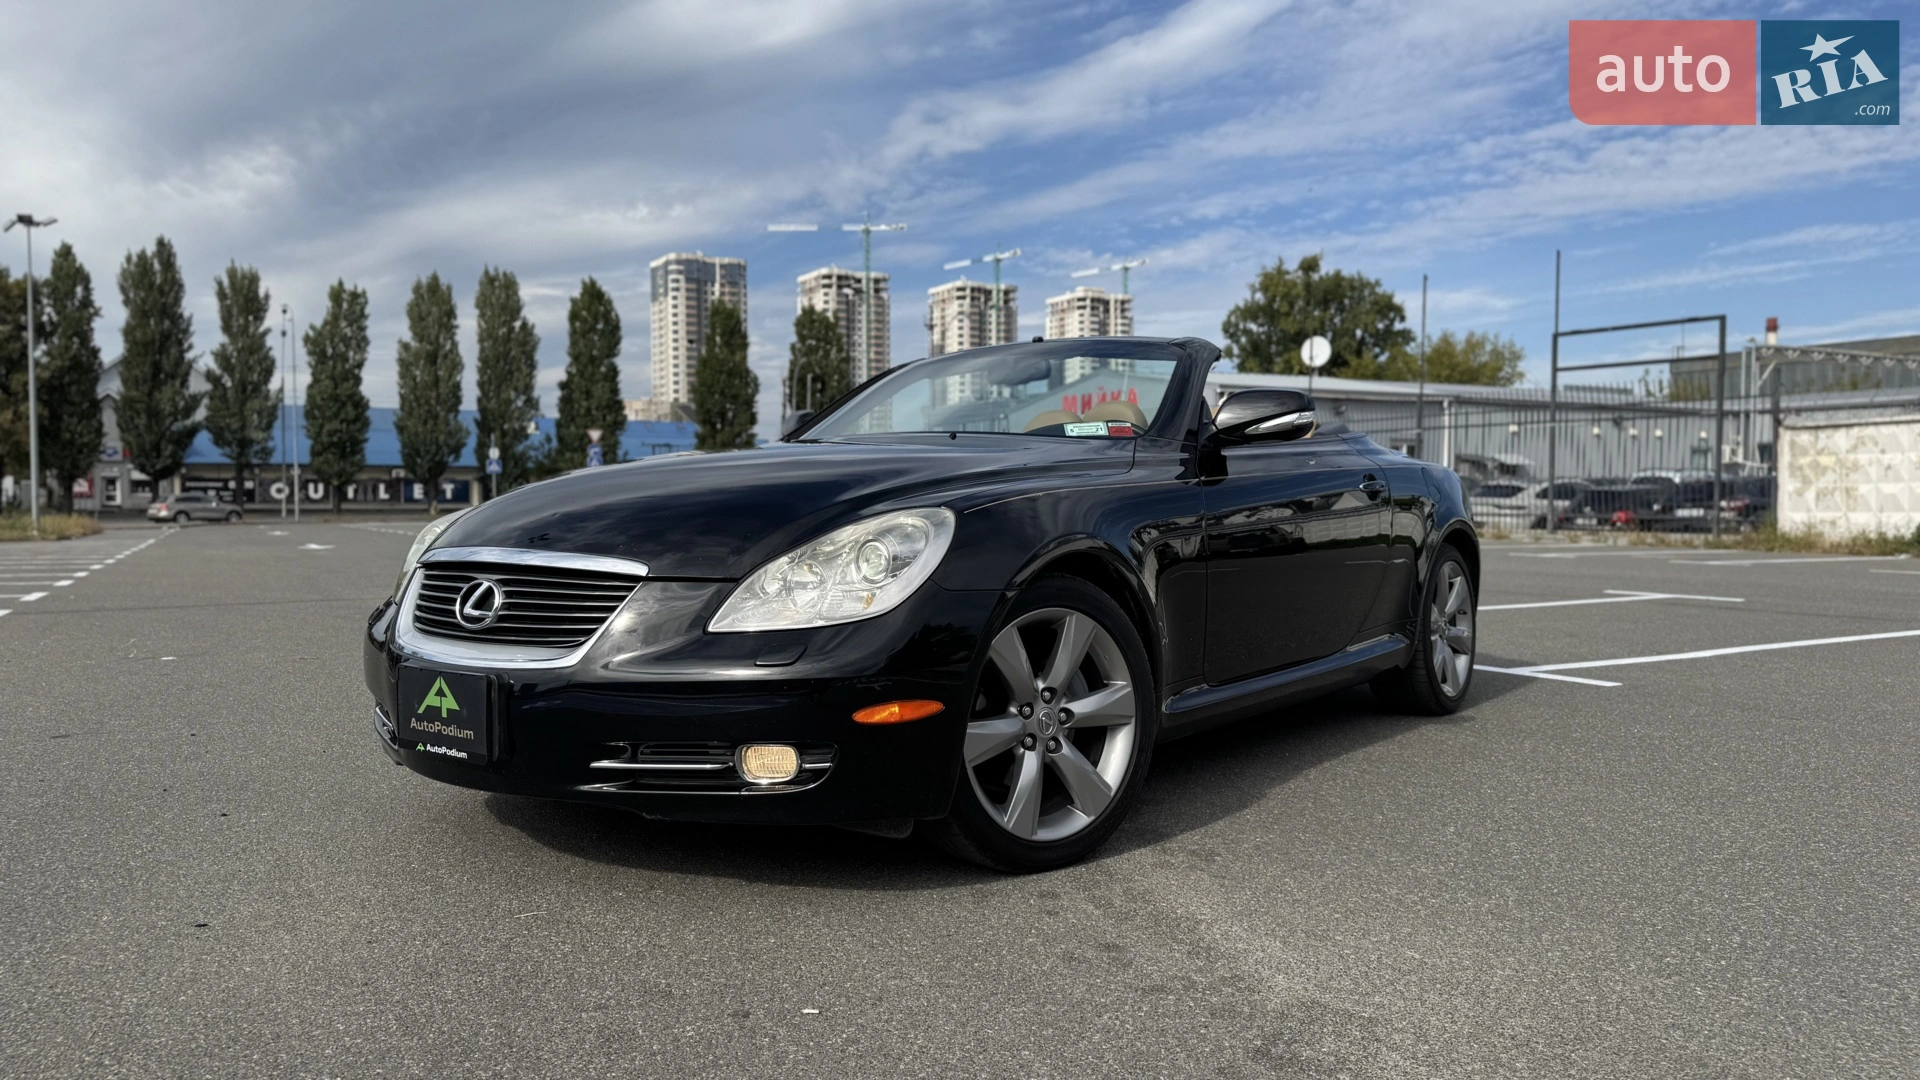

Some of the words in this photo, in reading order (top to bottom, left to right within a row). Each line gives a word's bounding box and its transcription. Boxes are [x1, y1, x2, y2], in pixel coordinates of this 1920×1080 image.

[269, 482, 454, 500] OUTLET
[410, 717, 474, 740] AutoPodium
[426, 743, 467, 759] AutoPodium
